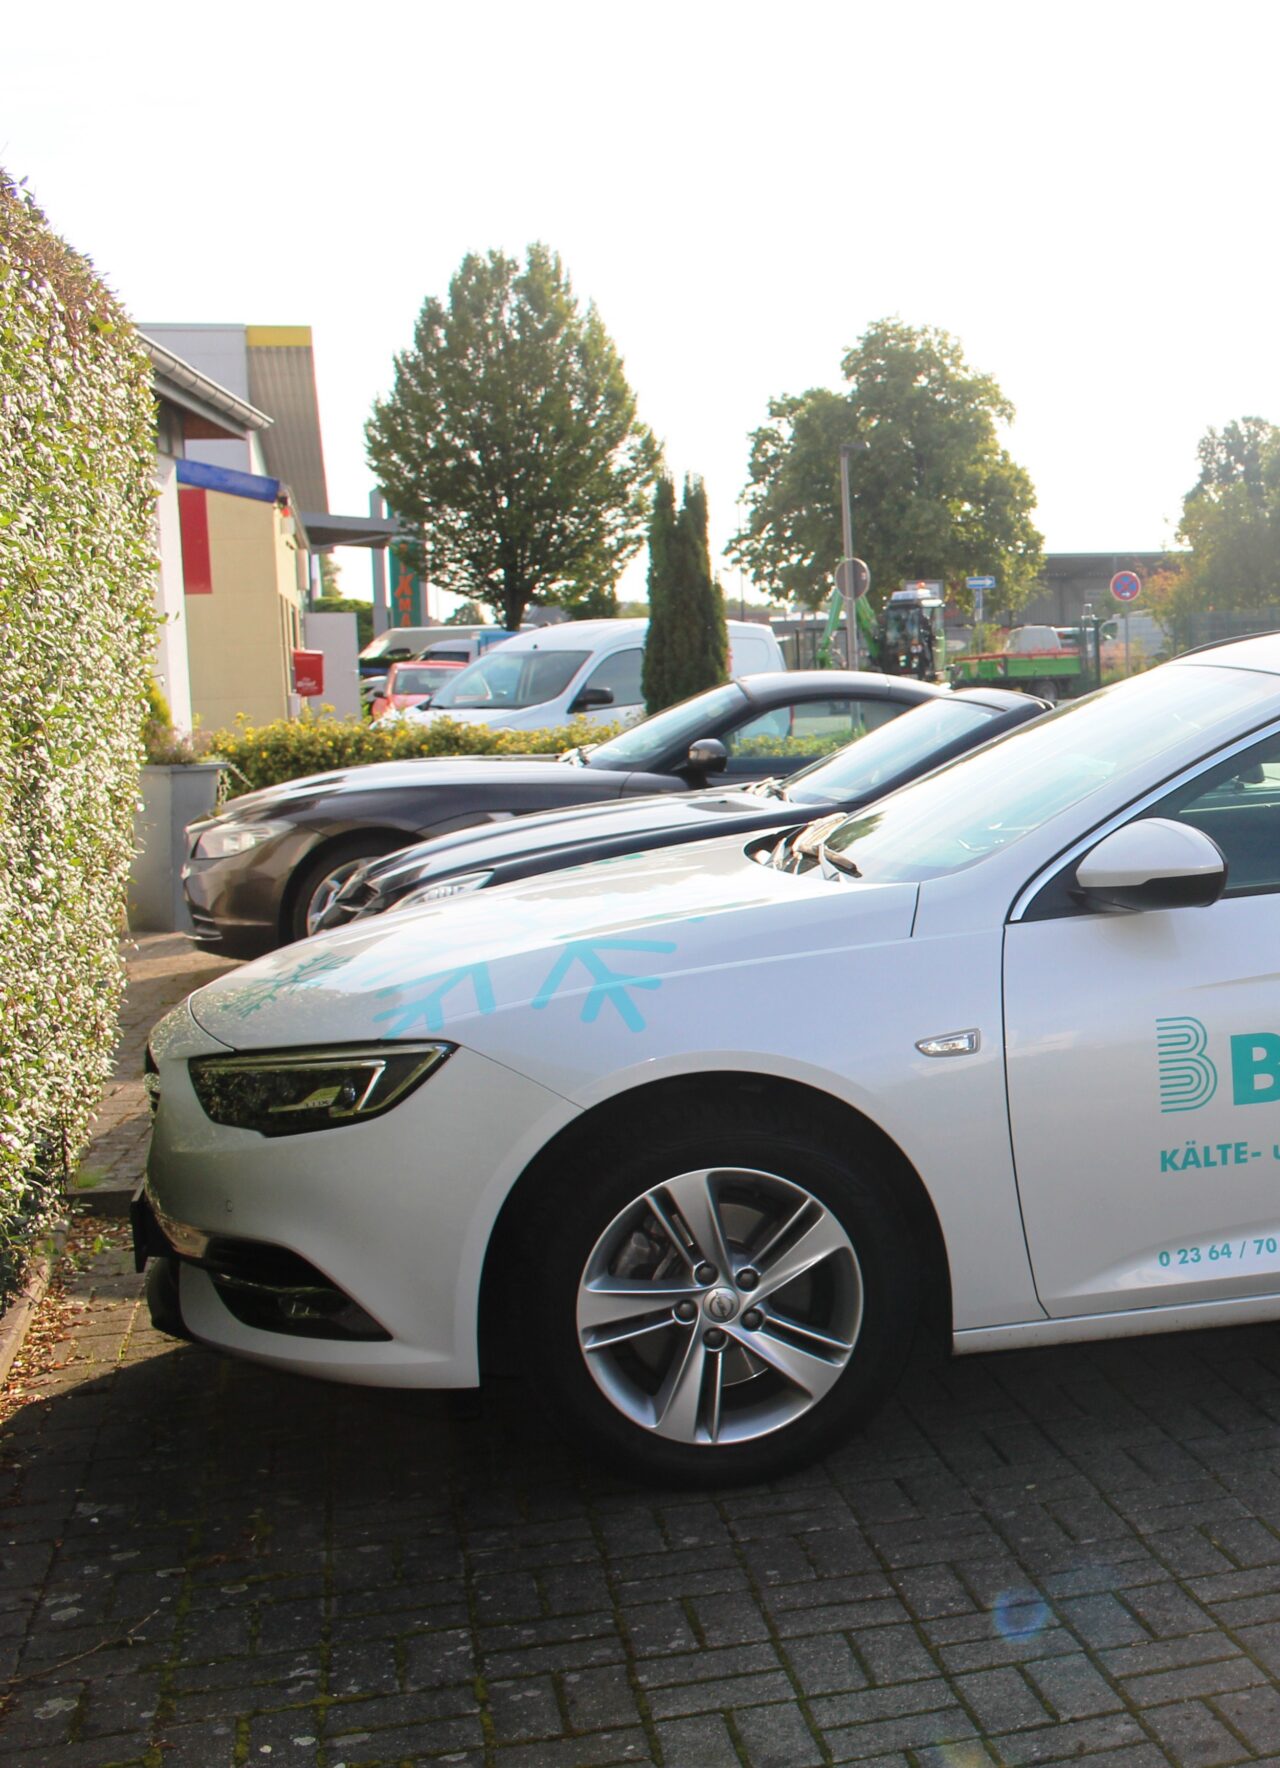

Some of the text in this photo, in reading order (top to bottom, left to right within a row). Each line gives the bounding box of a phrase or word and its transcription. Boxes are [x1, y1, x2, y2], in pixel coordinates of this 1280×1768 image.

[1159, 1141, 1262, 1173] KÄLTE-
[1158, 1252, 1171, 1268] 0
[1177, 1248, 1202, 1265] 23
[1208, 1243, 1233, 1261] 64
[1253, 1238, 1278, 1256] 70
